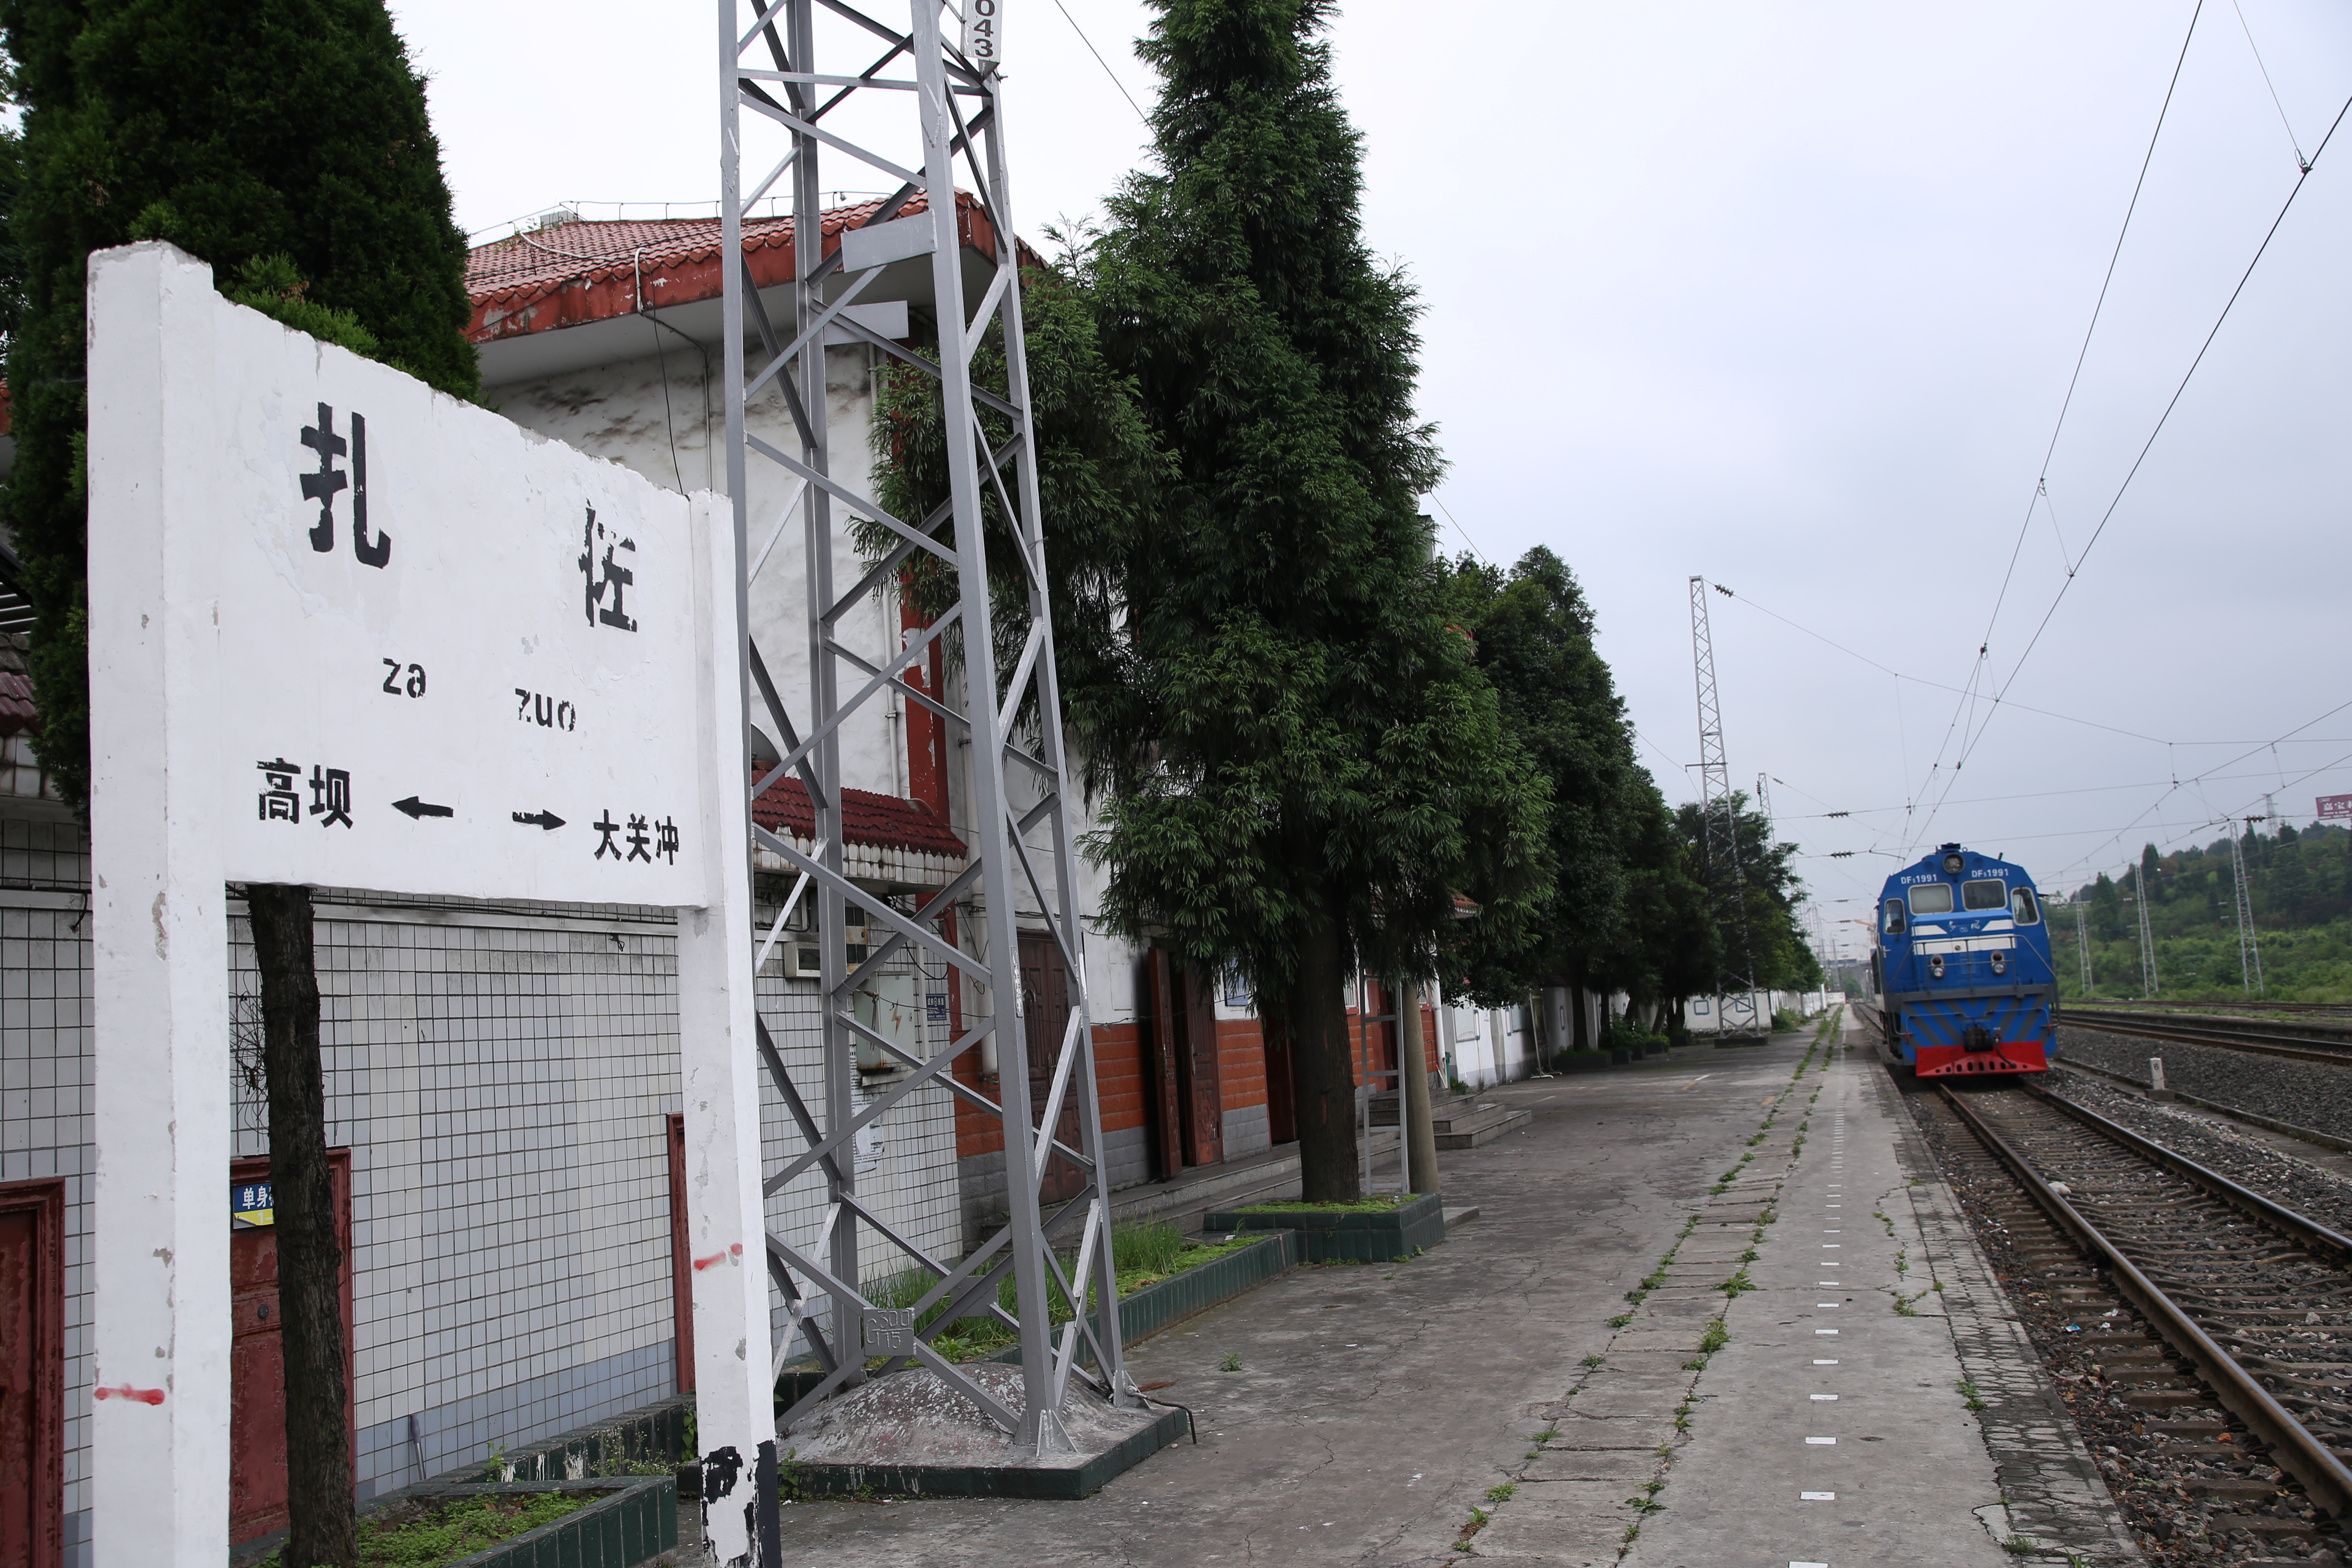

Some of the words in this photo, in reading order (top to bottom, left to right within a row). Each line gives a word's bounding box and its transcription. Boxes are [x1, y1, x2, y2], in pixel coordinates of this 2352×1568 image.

[974, 0, 995, 57] 043
[300, 402, 391, 569] 扎
[579, 499, 637, 632] 佐
[383, 658, 426, 698] za
[515, 688, 576, 732] zuo
[257, 758, 353, 829] 高坝
[593, 809, 679, 865] 大关冲
[242, 1186, 274, 1210] 单身
